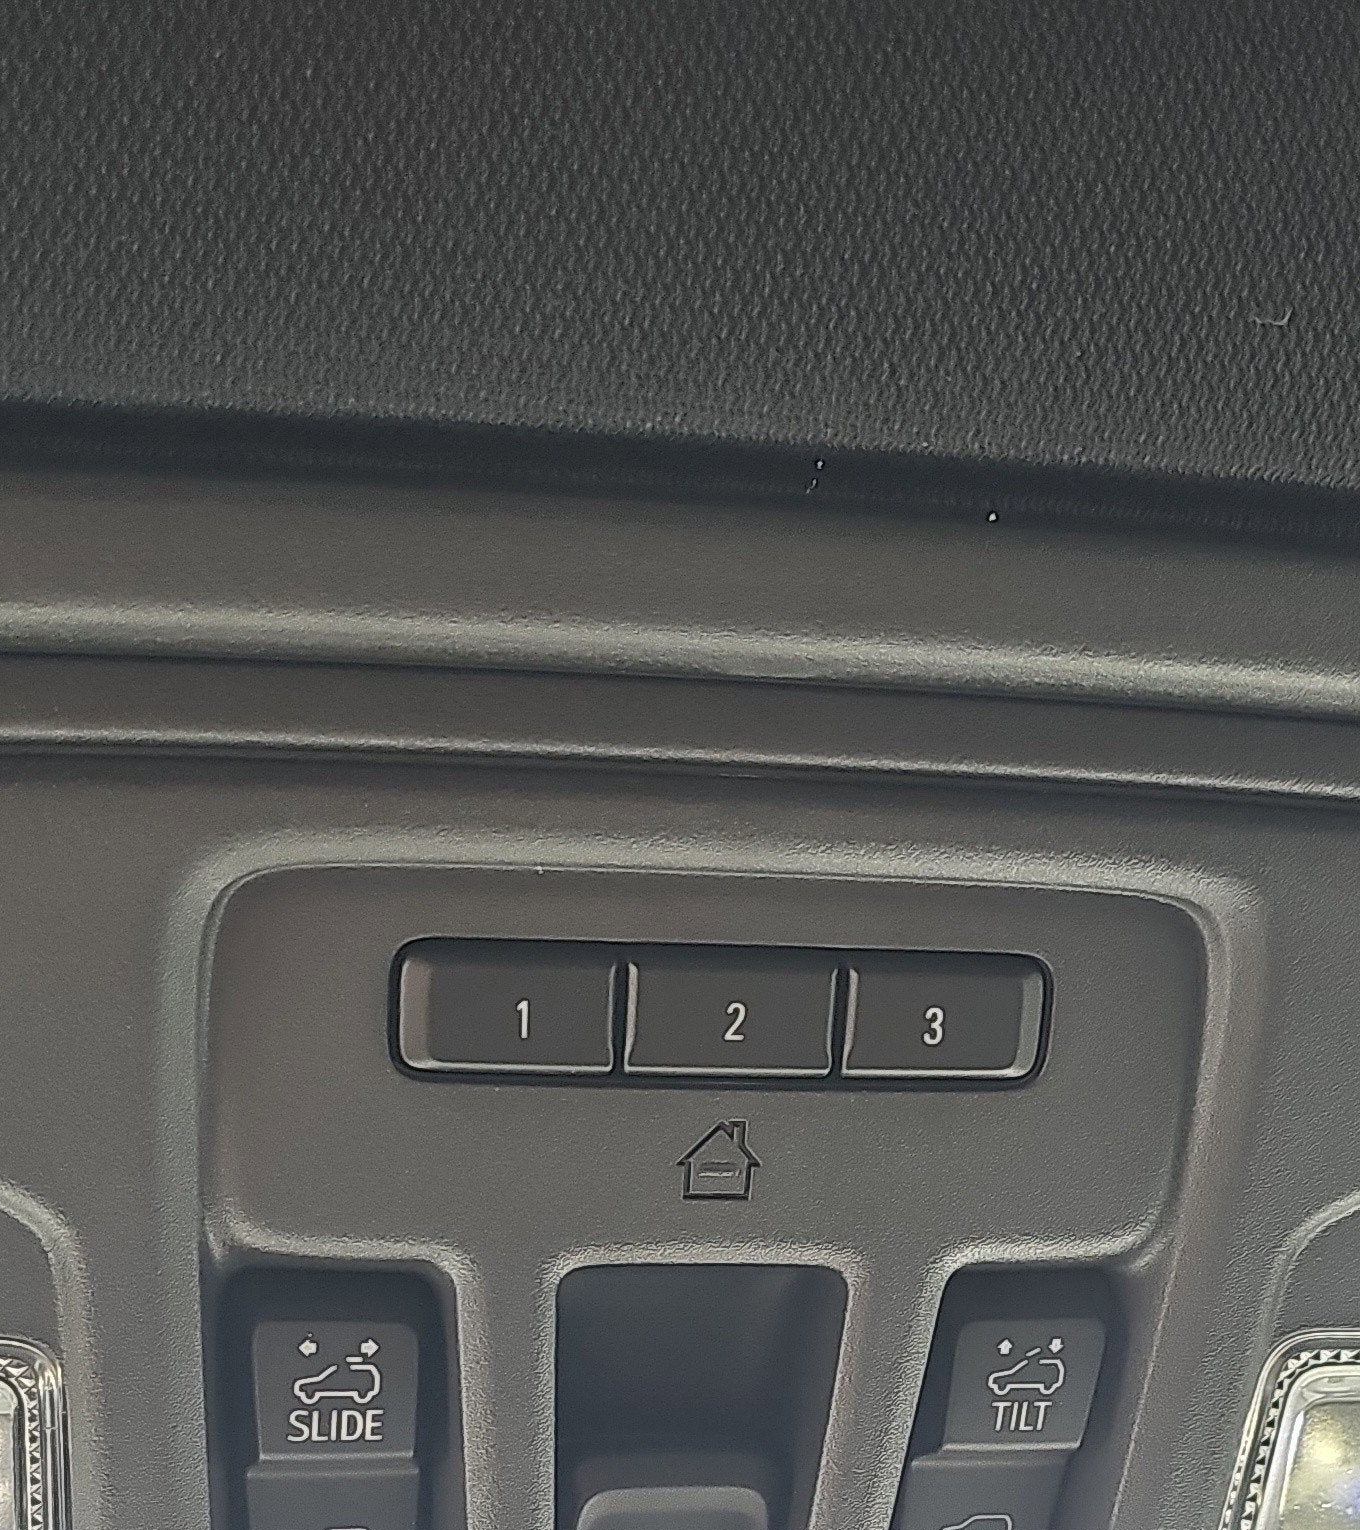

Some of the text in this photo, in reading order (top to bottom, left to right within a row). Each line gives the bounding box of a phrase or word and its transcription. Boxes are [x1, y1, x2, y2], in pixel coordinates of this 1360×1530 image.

[515, 1000, 529, 1039] 1
[723, 1002, 747, 1041] 2
[922, 1006, 945, 1045] 3
[286, 1408, 384, 1443] SLIDE
[991, 1400, 1052, 1434] TILT
